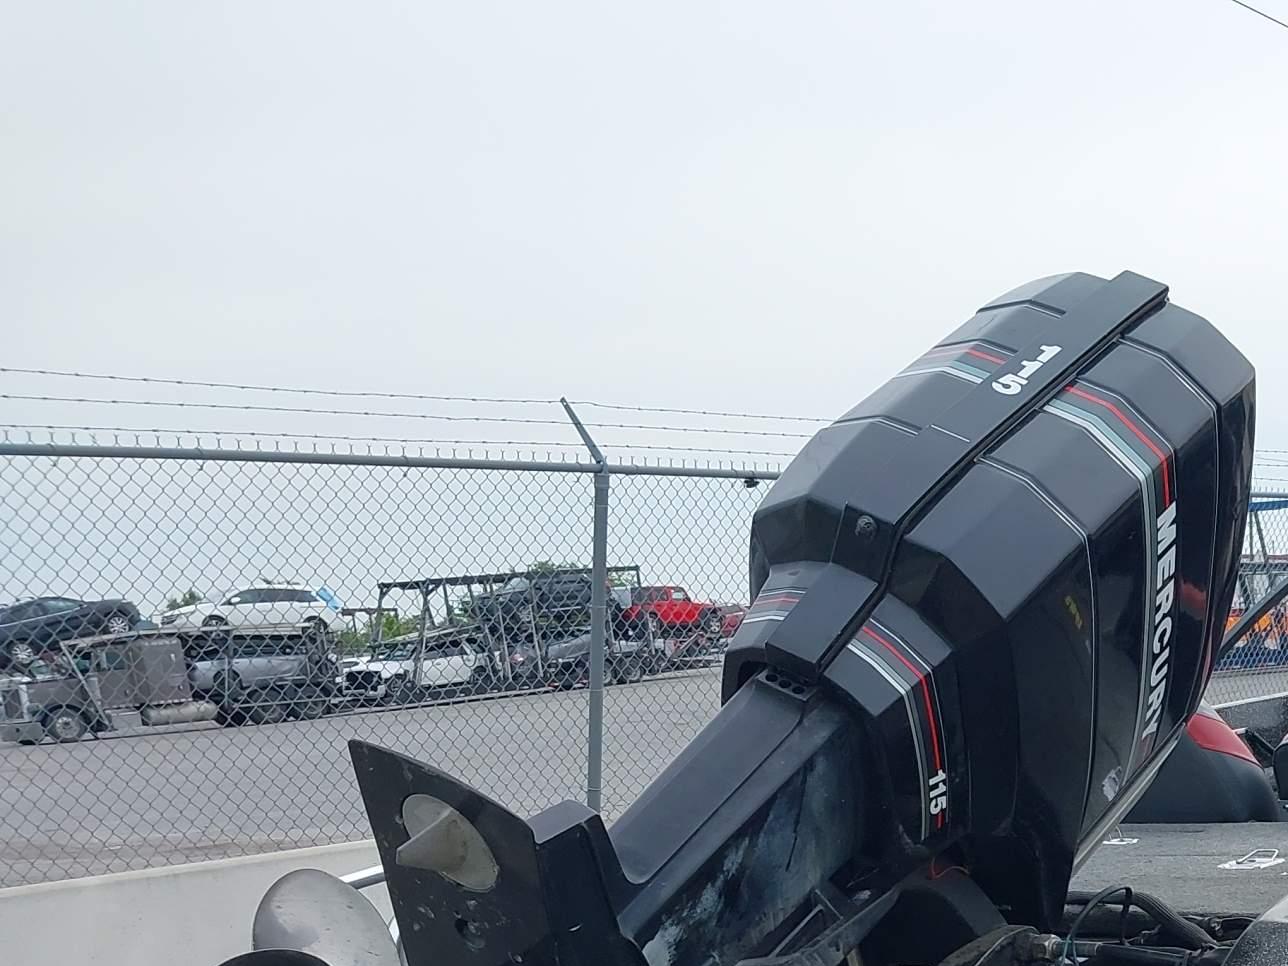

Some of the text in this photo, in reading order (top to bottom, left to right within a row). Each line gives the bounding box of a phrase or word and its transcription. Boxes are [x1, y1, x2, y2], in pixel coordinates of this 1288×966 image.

[991, 344, 1062, 395] 115
[1141, 500, 1178, 741] MERCURY
[928, 768, 948, 815] 115
